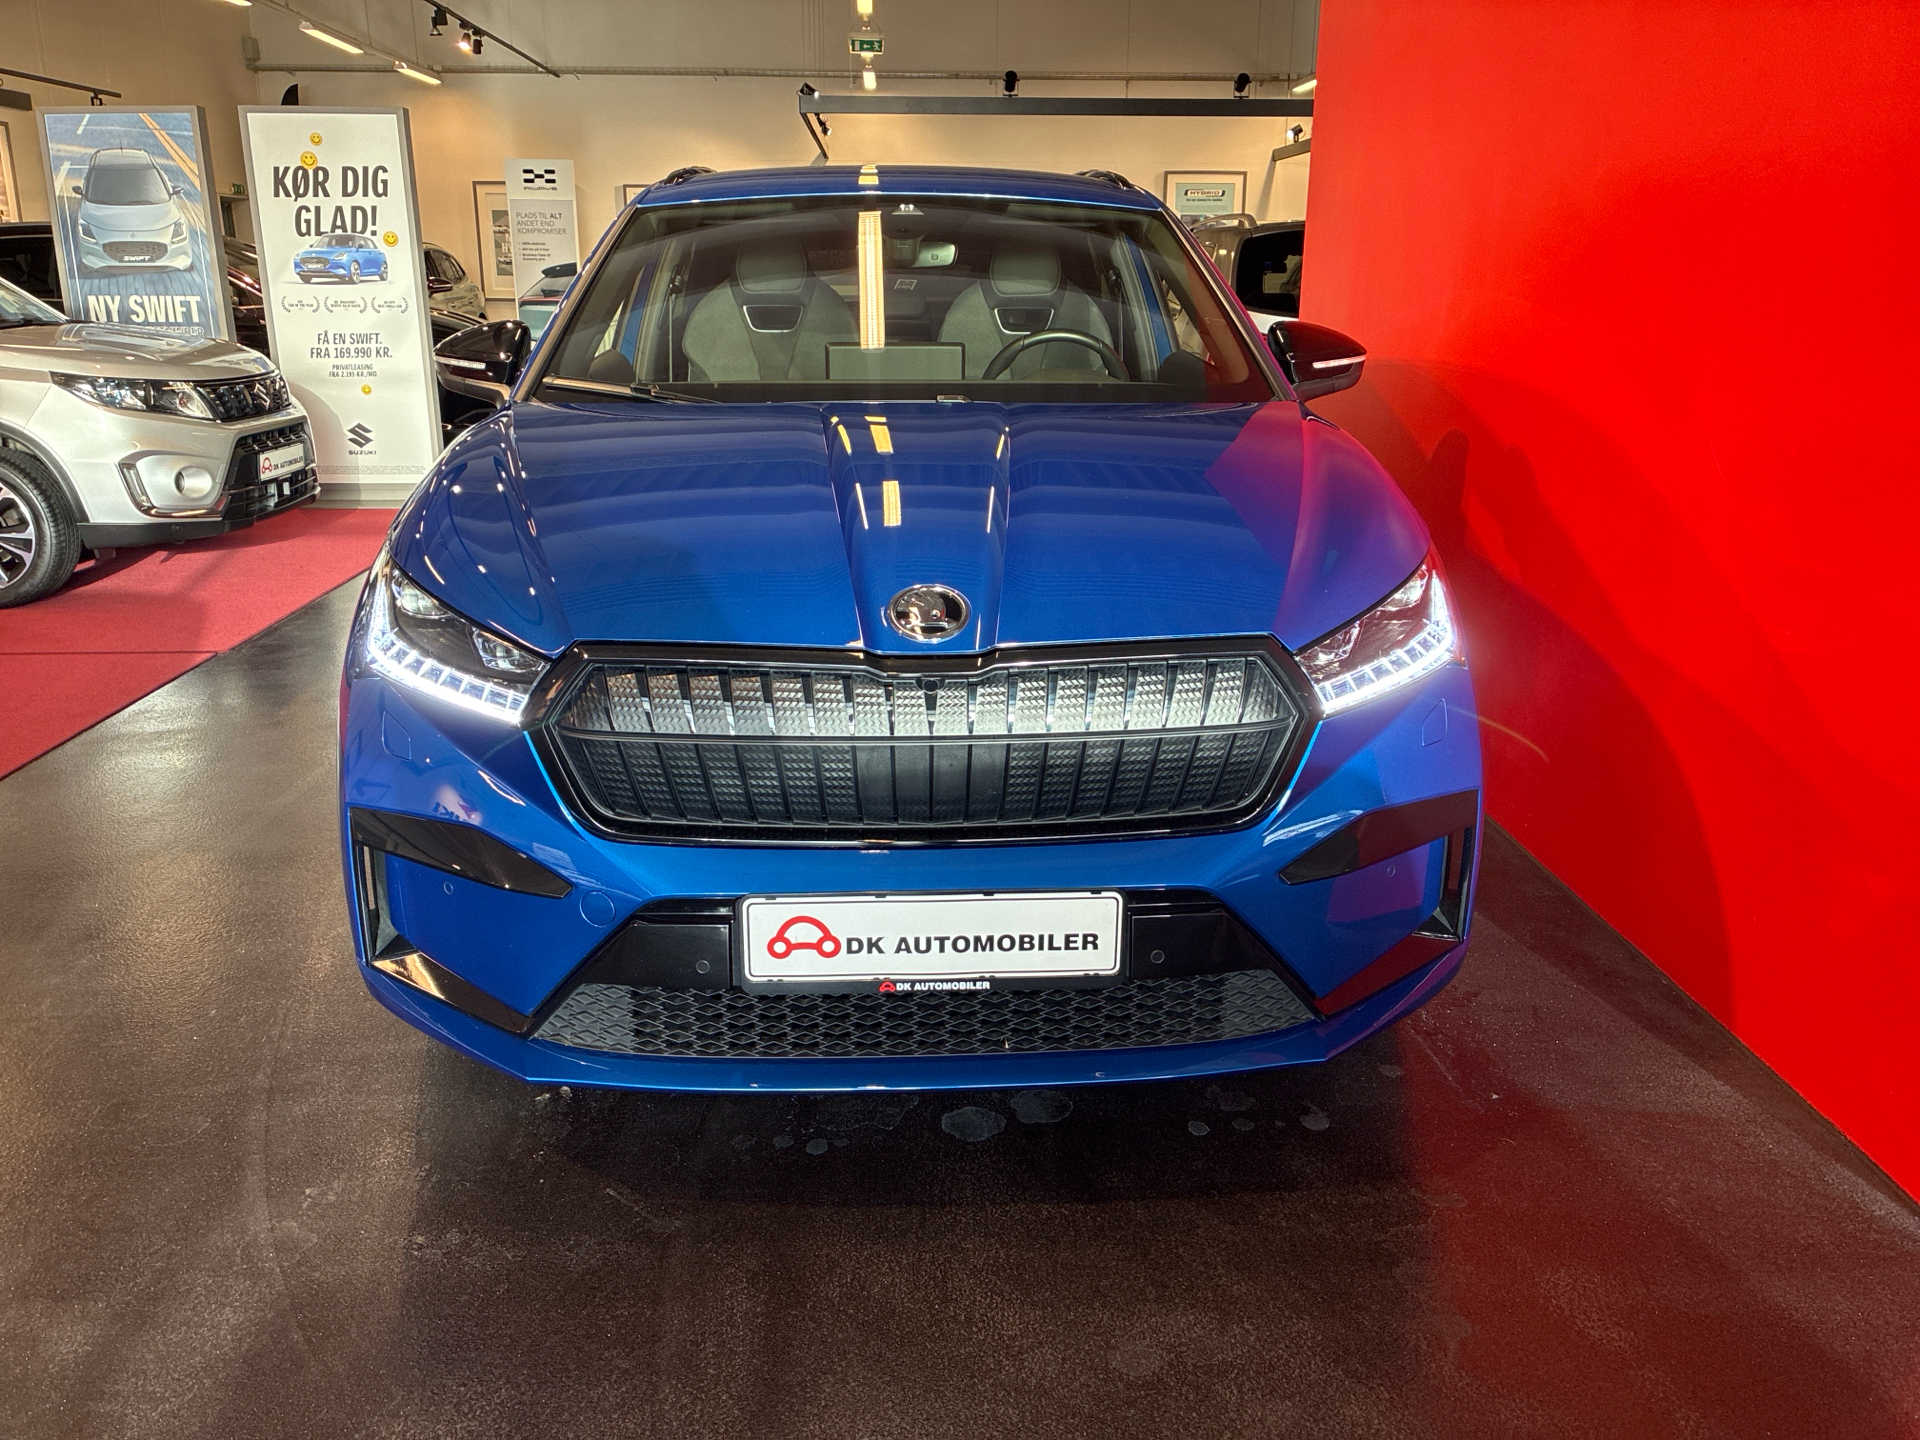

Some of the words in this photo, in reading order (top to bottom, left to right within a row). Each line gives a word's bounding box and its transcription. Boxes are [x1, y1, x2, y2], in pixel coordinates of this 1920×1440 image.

[273, 166, 330, 202] KØR
[341, 165, 388, 198] DIG
[294, 205, 377, 237] GLAD!
[87, 294, 120, 322] NY
[128, 294, 200, 323] SWIFT
[318, 330, 330, 344] FÅ
[333, 332, 346, 344] EN
[350, 332, 382, 344] SWIFT.
[310, 348, 330, 358] FRA
[334, 347, 372, 358] 169.990
[376, 346, 392, 358] KR.
[280, 456, 303, 469] AUTOMOBILER
[846, 937, 885, 954] DK
[894, 934, 1099, 954] AUTOMOBILER
[896, 982, 912, 991] DK
[914, 981, 990, 990] AUTOMOBILER
